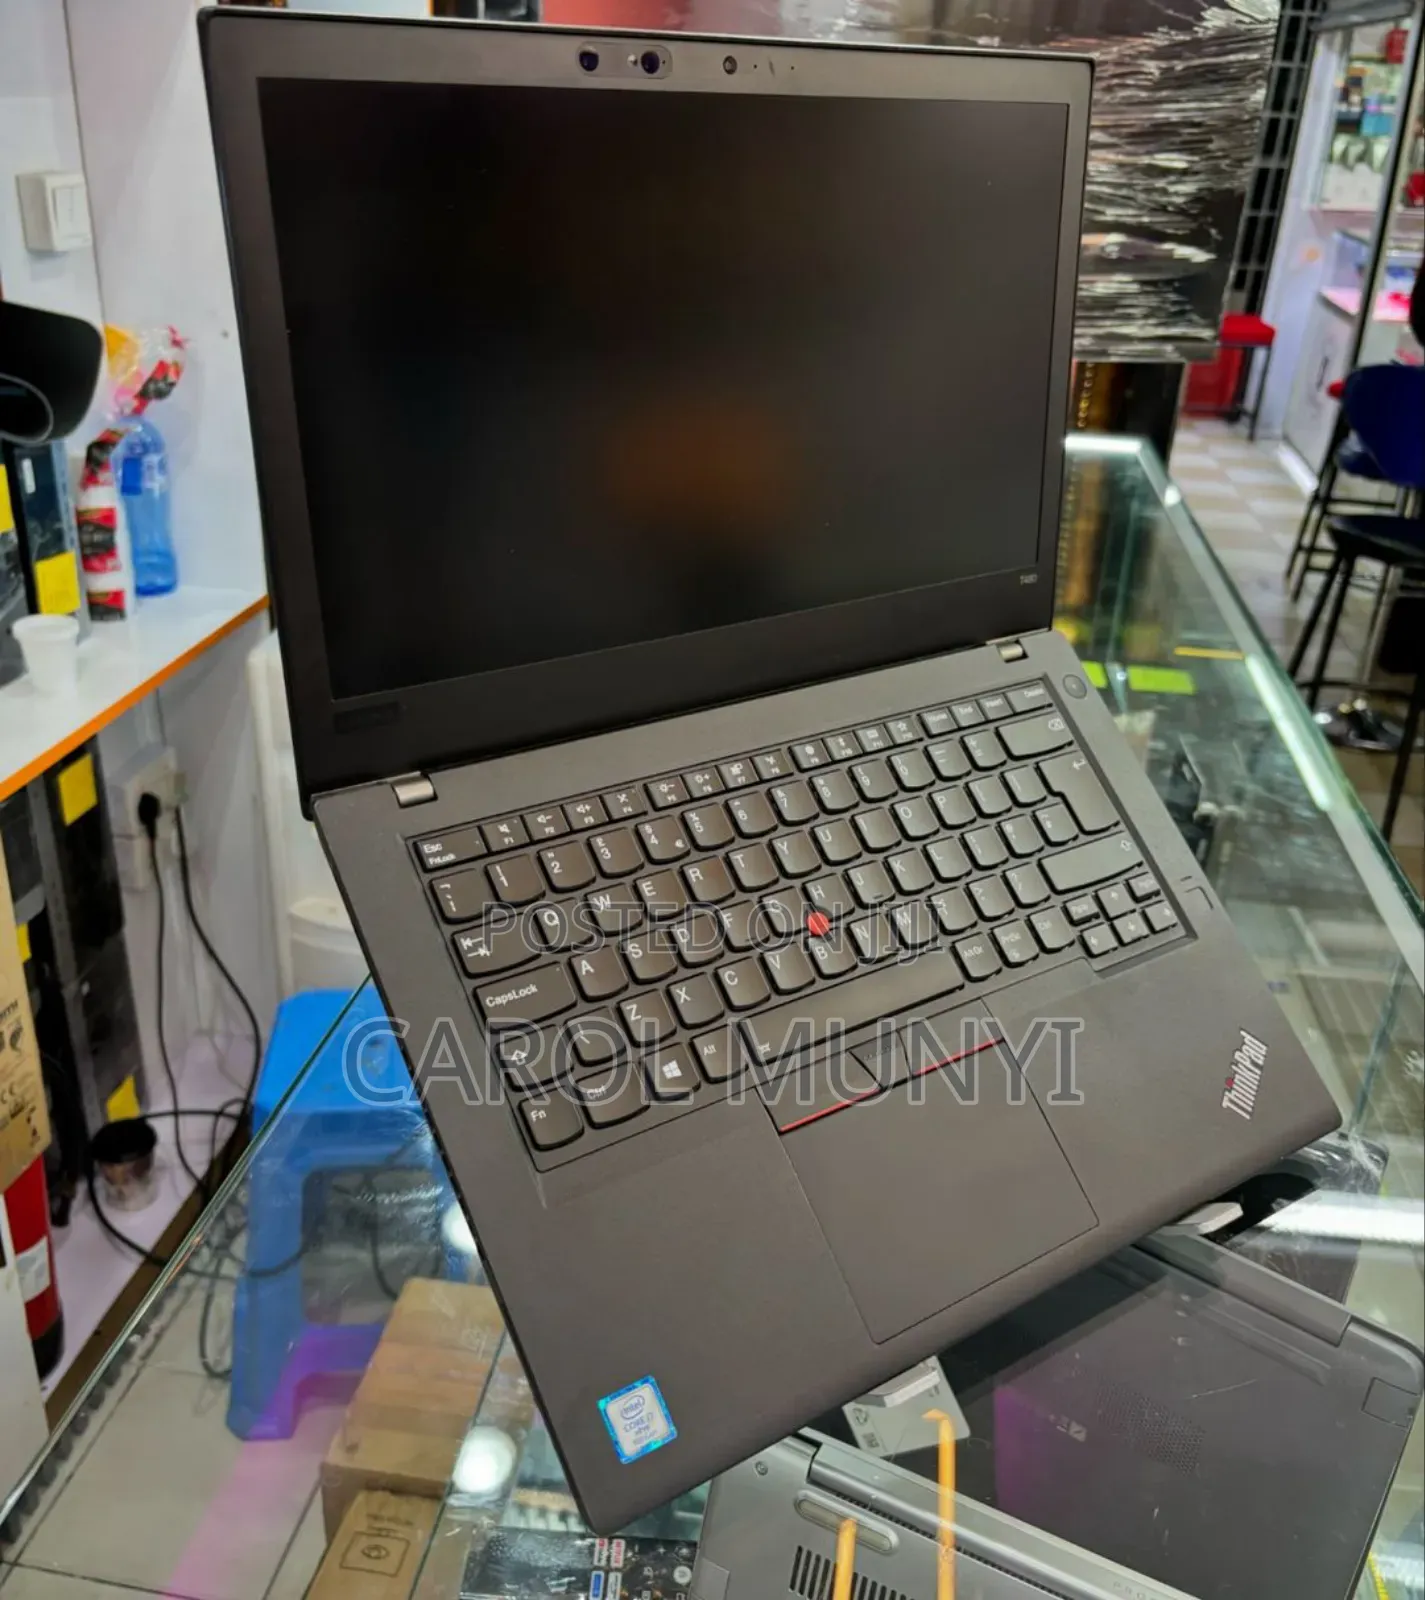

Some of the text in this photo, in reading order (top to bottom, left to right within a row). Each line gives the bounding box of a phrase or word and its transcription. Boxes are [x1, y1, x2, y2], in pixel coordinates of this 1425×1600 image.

[819, 829, 833, 844] U
[550, 860, 563, 875] 2
[732, 853, 746, 869] T
[688, 867, 705, 883] R
[641, 880, 657, 897] E
[810, 884, 827, 901] H
[592, 893, 612, 912] W
[543, 909, 561, 927] Q
[676, 927, 691, 944] D
[627, 942, 644, 959] S
[814, 945, 829, 960] B
[580, 959, 595, 976] A
[768, 953, 782, 970] V
[723, 970, 739, 986] C
[485, 983, 539, 1007] CapsLock
[675, 986, 692, 1004] X
[625, 1003, 642, 1021] Z
[702, 1043, 717, 1057] Alt
[1222, 1029, 1269, 1120] ThinkPad
[530, 1108, 547, 1123] Fn
